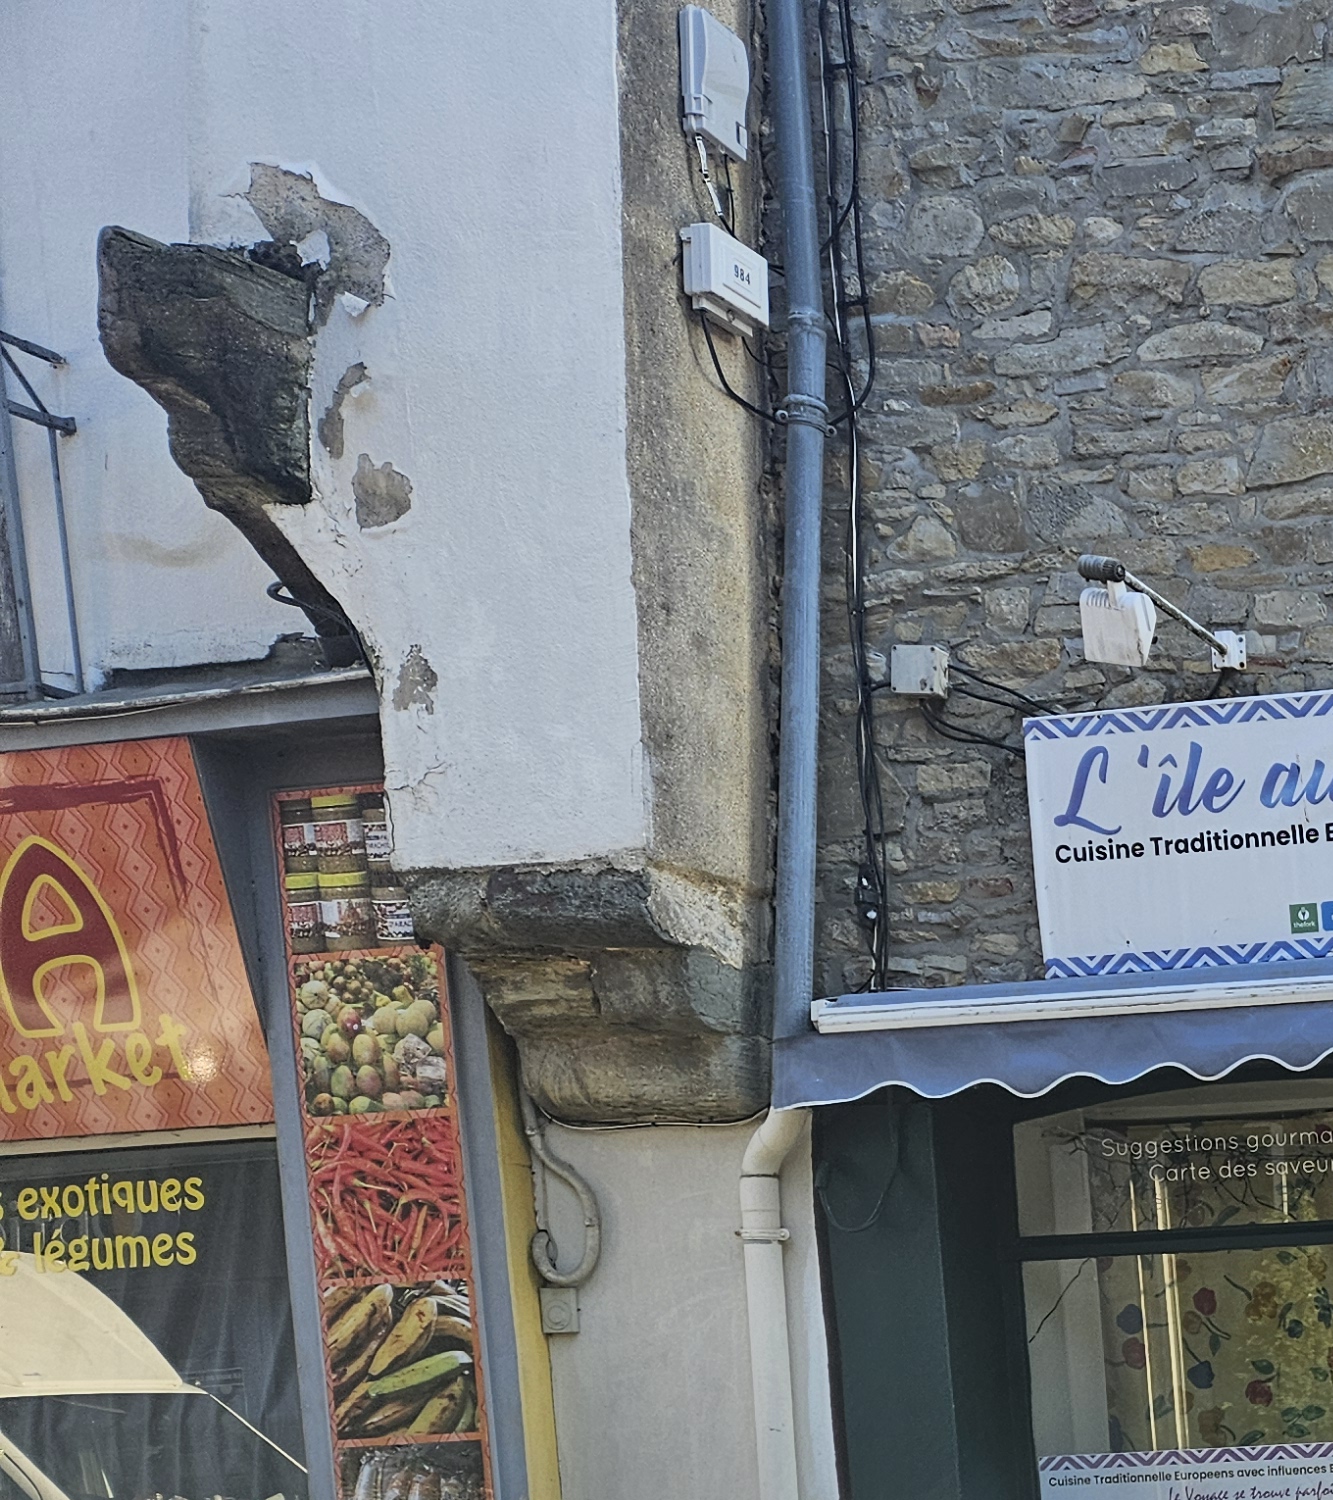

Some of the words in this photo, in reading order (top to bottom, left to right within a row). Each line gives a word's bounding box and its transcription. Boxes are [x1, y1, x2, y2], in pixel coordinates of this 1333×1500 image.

[734, 264, 750, 285] 984
[1053, 740, 1245, 836] L'île
[1055, 837, 1145, 864] Cuisine
[1150, 823, 1319, 856] Traditionnelle
[0, 1013, 193, 1114] arket
[1101, 1135, 1239, 1160] Suggestions
[1148, 1162, 1210, 1184] Carte
[1219, 1159, 1257, 1178] des
[17, 1173, 205, 1221] exotiques
[33, 1231, 197, 1274] légumes
[1049, 1474, 1091, 1487] Cuisine
[1094, 1470, 1172, 1485] Traditionnelle
[1174, 1467, 1233, 1484] Europeens
[1237, 1467, 1264, 1479] avec
[1267, 1463, 1327, 1477] influences
[1234, 1489, 1247, 1500] se
[1249, 1482, 1291, 1499] trouve
